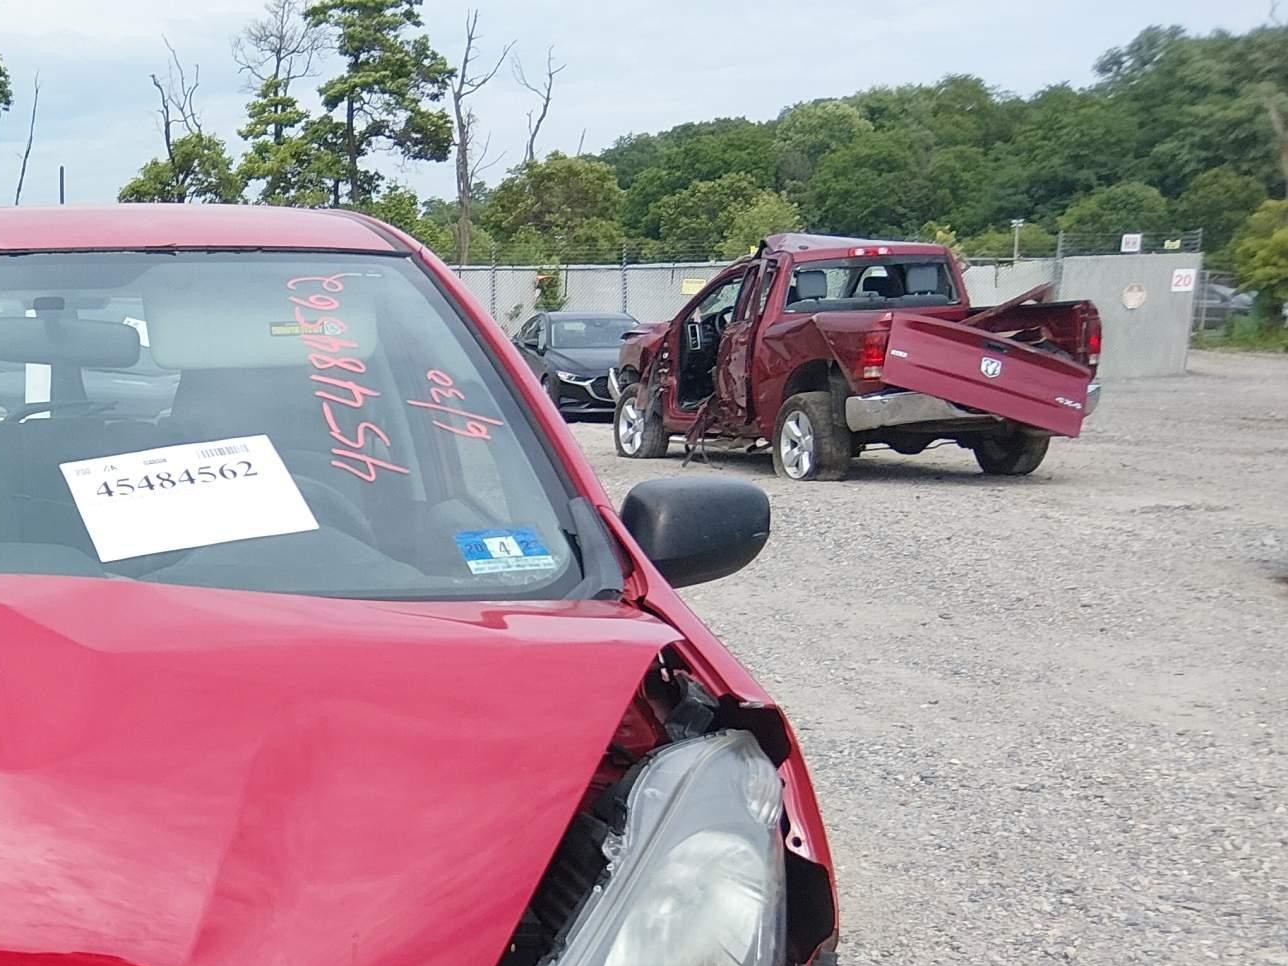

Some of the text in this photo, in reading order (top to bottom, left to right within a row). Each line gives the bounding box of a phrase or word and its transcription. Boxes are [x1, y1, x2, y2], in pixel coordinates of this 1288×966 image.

[1174, 274, 1192, 287] 20
[287, 273, 410, 481] 45484562
[407, 369, 505, 440] 6/30
[97, 460, 258, 497] 45484562
[499, 541, 511, 555] 4
